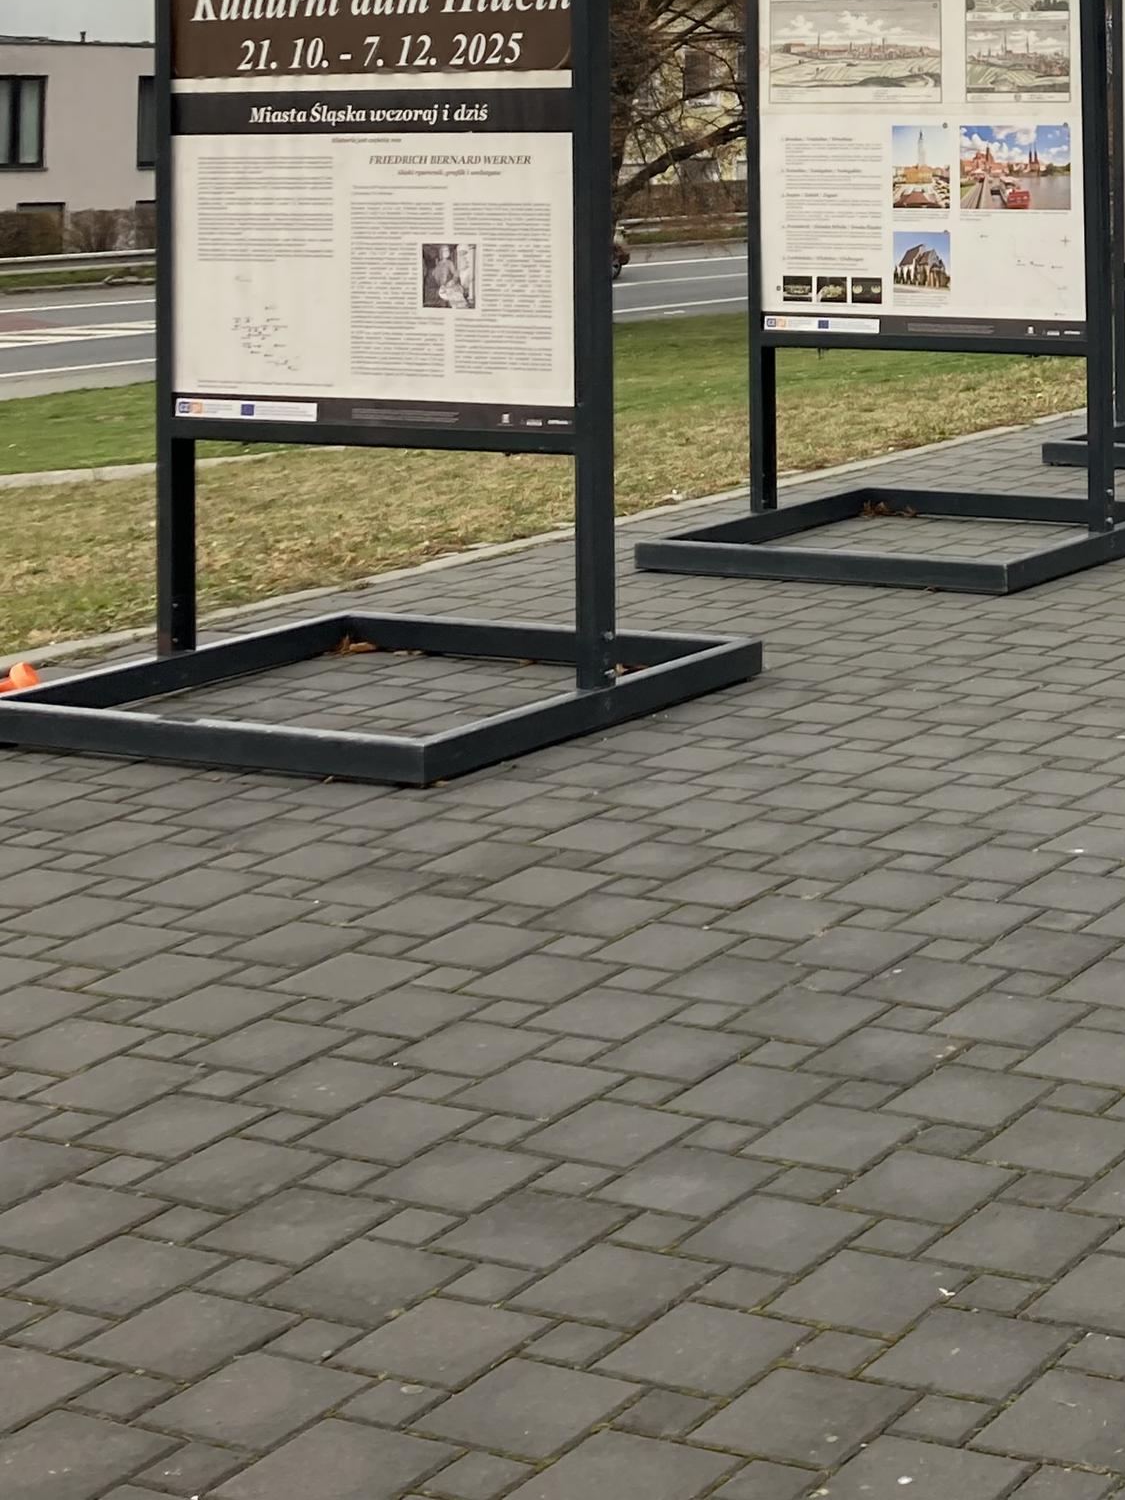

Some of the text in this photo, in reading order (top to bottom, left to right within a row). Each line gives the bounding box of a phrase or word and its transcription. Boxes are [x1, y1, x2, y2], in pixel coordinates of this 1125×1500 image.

[237, 39, 278, 70] 21.
[288, 37, 329, 68] 10.
[363, 36, 385, 67] 7.
[395, 34, 437, 66] 12.
[449, 32, 524, 65] 2025
[249, 102, 488, 126] Miasta Śląska wczoraj i dziś
[369, 155, 532, 165] FRIEDRICH BERNARD WERNER
